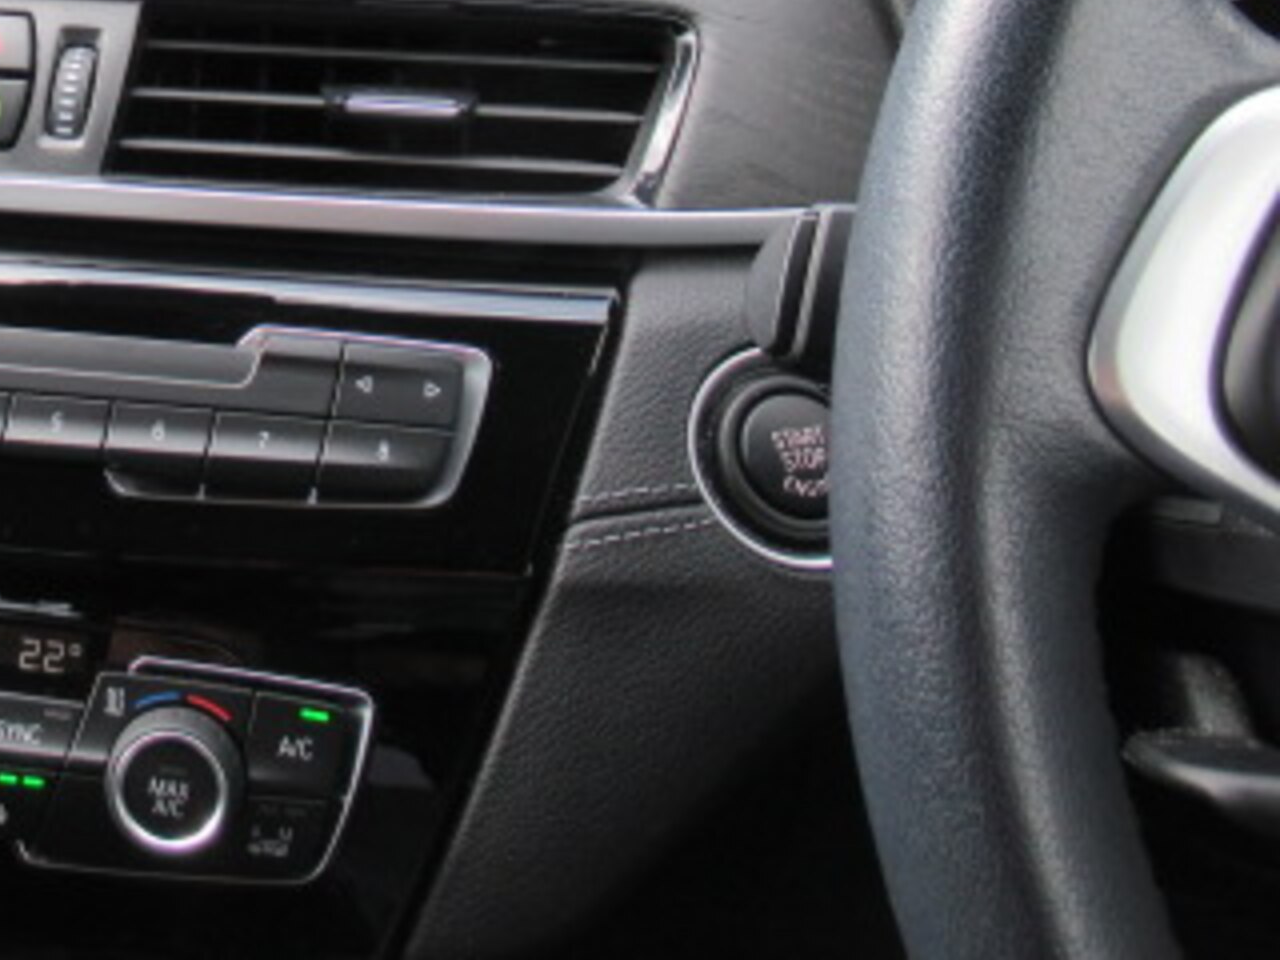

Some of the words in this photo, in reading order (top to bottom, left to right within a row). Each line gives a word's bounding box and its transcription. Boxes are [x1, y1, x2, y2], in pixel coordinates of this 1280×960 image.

[51, 411, 62, 432] 5
[151, 420, 165, 440] 6
[258, 431, 270, 450] 7
[277, 735, 313, 761] A/C
[147, 777, 190, 802] MAX
[151, 796, 186, 818] A/C
